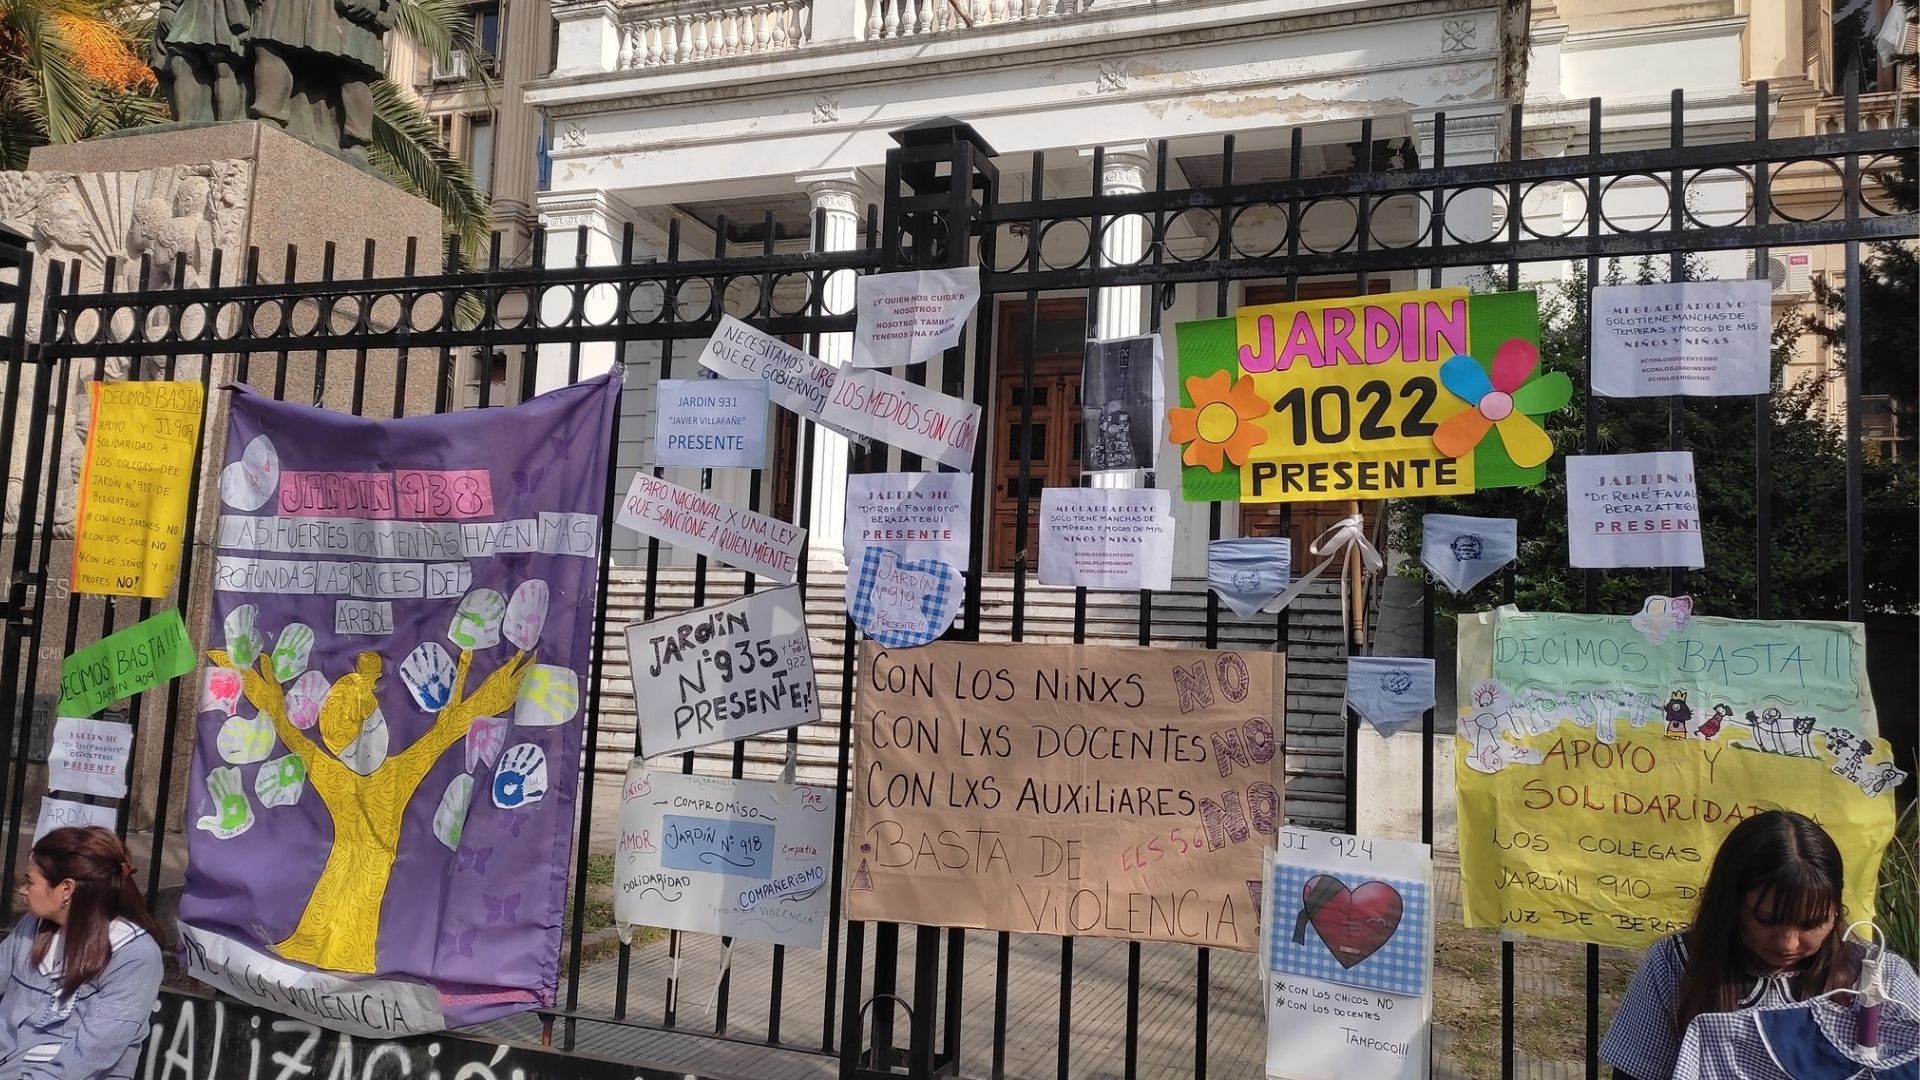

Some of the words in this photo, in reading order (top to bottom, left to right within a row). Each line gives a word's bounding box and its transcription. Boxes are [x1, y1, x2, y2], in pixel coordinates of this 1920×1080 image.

[894, 306, 941, 315] NOSOTROS?
[1606, 317, 1635, 325] SOLO
[1672, 313, 1726, 321] MANCHAS
[1729, 312, 1745, 320] DE
[877, 319, 917, 329] NOSOTROS
[1613, 327, 1666, 335] TEMPERAS
[1679, 325, 1713, 333] MOCOS
[872, 331, 908, 341] TENEMOS
[1238, 299, 1466, 374] JARDIN
[1624, 338, 1668, 348] NIÑOS
[712, 342, 739, 365] QUE
[741, 354, 756, 373] EL
[103, 389, 151, 407] DECIMOS
[678, 397, 715, 408] JARDIN
[719, 397, 737, 408] 931
[833, 379, 865, 412] LOS
[918, 410, 951, 441] SON
[1273, 376, 1439, 446] 1022
[98, 420, 125, 432] APOYO
[141, 423, 149, 434] Y
[174, 419, 194, 441] 909
[96, 438, 152, 451] SOLIDARIDAD
[161, 444, 168, 452] A
[668, 435, 744, 450] PRESENTE
[96, 457, 111, 467] LOS
[117, 459, 153, 472] COLEGAS
[160, 464, 179, 476] DEL
[1251, 457, 1457, 496] PRESENTE
[1597, 473, 1678, 487] JARDIN
[93, 491, 140, 508] BERAZATEGUI
[157, 486, 170, 496] DE
[281, 472, 391, 513] JARDIN
[400, 472, 483, 516] 938
[867, 490, 924, 500] JARDIN
[627, 495, 653, 518] QUE
[708, 525, 719, 545] A
[640, 476, 669, 500] PARO
[725, 508, 737, 526] X
[742, 515, 768, 537] UNA
[770, 523, 798, 546] LEY
[112, 515, 126, 525] LOS
[166, 524, 178, 535] NO
[863, 530, 952, 539] PRESENTE
[107, 534, 119, 544] LOS
[151, 541, 166, 550] NO
[217, 517, 270, 548] LAS
[275, 517, 349, 550] FUERTES
[351, 522, 460, 559] TORMENTAS
[463, 525, 532, 553] HACEN
[1109, 535, 1143, 543] NIÑAS
[82, 574, 110, 586] PROFES
[116, 576, 140, 589] NO!
[316, 562, 350, 593] LAS
[431, 564, 466, 596] DEL
[787, 656, 806, 670] 922
[135, 670, 154, 687] 909
[872, 651, 934, 698] CON
[955, 661, 1015, 701] LOS
[1172, 651, 1250, 715] NO
[872, 709, 939, 754] CON
[960, 718, 1012, 758] LXS
[1031, 723, 1207, 763] DOCENTES
[1210, 716, 1276, 778] NO
[63, 761, 116, 774] PRESENTE
[1540, 737, 1656, 774] APOYO
[1703, 747, 1723, 784] Y
[867, 760, 935, 808] CON
[949, 771, 1001, 809] LXS
[1199, 780, 1280, 853] NO
[618, 829, 653, 853] AMOR
[740, 836, 762, 855] 918
[1170, 827, 1203, 854] 56
[1329, 836, 1374, 861] 924
[1493, 830, 1550, 852] LOS
[1578, 835, 1703, 863] COLEGAS
[1028, 835, 1082, 880] DE
[1597, 875, 1651, 899] 910
[1552, 910, 1594, 926] DE
[223, 956, 241, 986] A
[245, 964, 277, 1003] LA
[1274, 980, 1309, 996] #CON
[1312, 990, 1331, 1001] LOS
[1377, 997, 1394, 1010] NO
[1275, 996, 1307, 1012] #CON
[1313, 1004, 1330, 1015] LOS
[1334, 1007, 1381, 1022] DOCENTES
